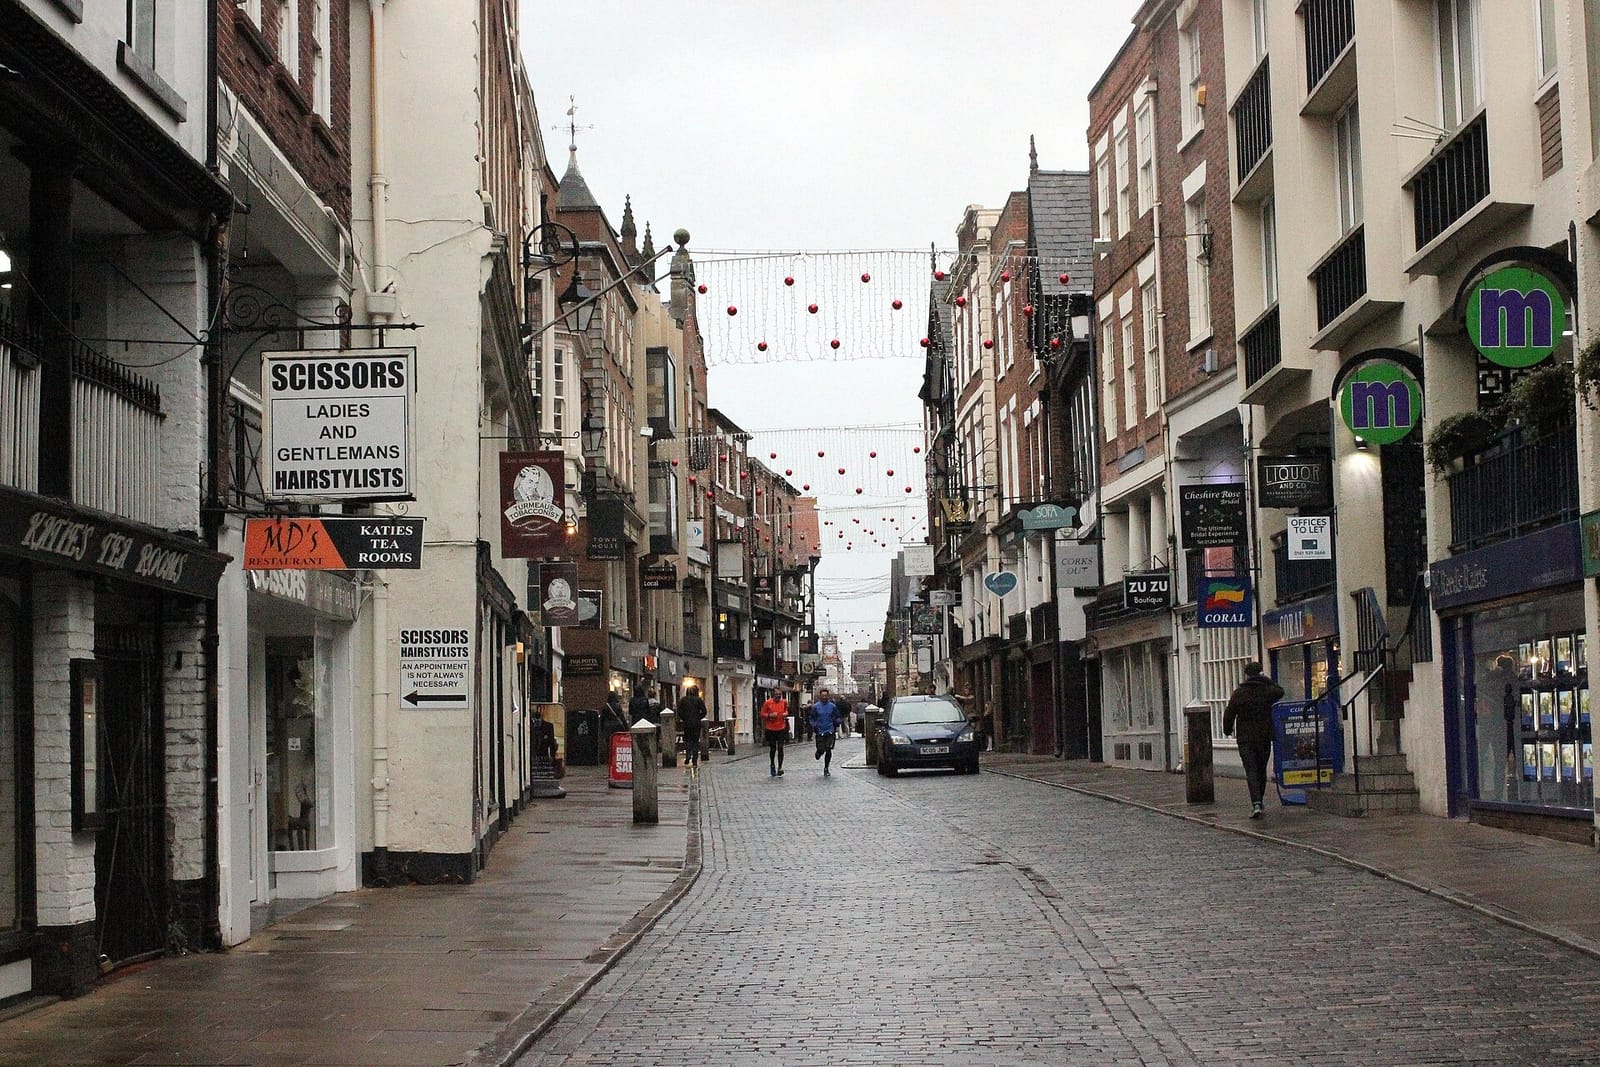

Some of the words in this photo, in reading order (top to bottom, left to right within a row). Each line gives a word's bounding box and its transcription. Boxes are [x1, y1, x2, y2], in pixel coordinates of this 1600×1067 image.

[1480, 289, 1552, 347] m
[272, 361, 404, 391] SCISSORS
[1351, 380, 1411, 429] m
[307, 404, 370, 418] LADIES
[319, 425, 357, 439] AND
[278, 445, 400, 461] GENTLEMANS
[275, 468, 404, 490] HAIRSTYLISTS
[1264, 465, 1320, 483] LIQUOR
[1185, 490, 1220, 500] Cheshire
[1221, 490, 1241, 499] Rose
[509, 508, 559, 520] TOBACCONIST
[1291, 518, 1327, 527] OFFICES
[360, 525, 414, 536] KATIES
[1294, 526, 1306, 534] TO
[1309, 525, 1324, 534] LET
[370, 539, 399, 549] TEA
[97, 532, 134, 570] TEA
[135, 543, 188, 584] ROOMS
[249, 557, 325, 565] RESTAURANT
[358, 553, 413, 563] ROOMS
[1061, 558, 1093, 566] CORKS
[1067, 567, 1088, 575] OUT
[1129, 581, 1146, 593] ZU
[1150, 581, 1168, 592] ZU
[1205, 614, 1246, 623] CORAL
[1280, 611, 1304, 639] CORAL
[401, 630, 468, 644] SCISSORS
[401, 647, 469, 657] HAIRSTYLISTS
